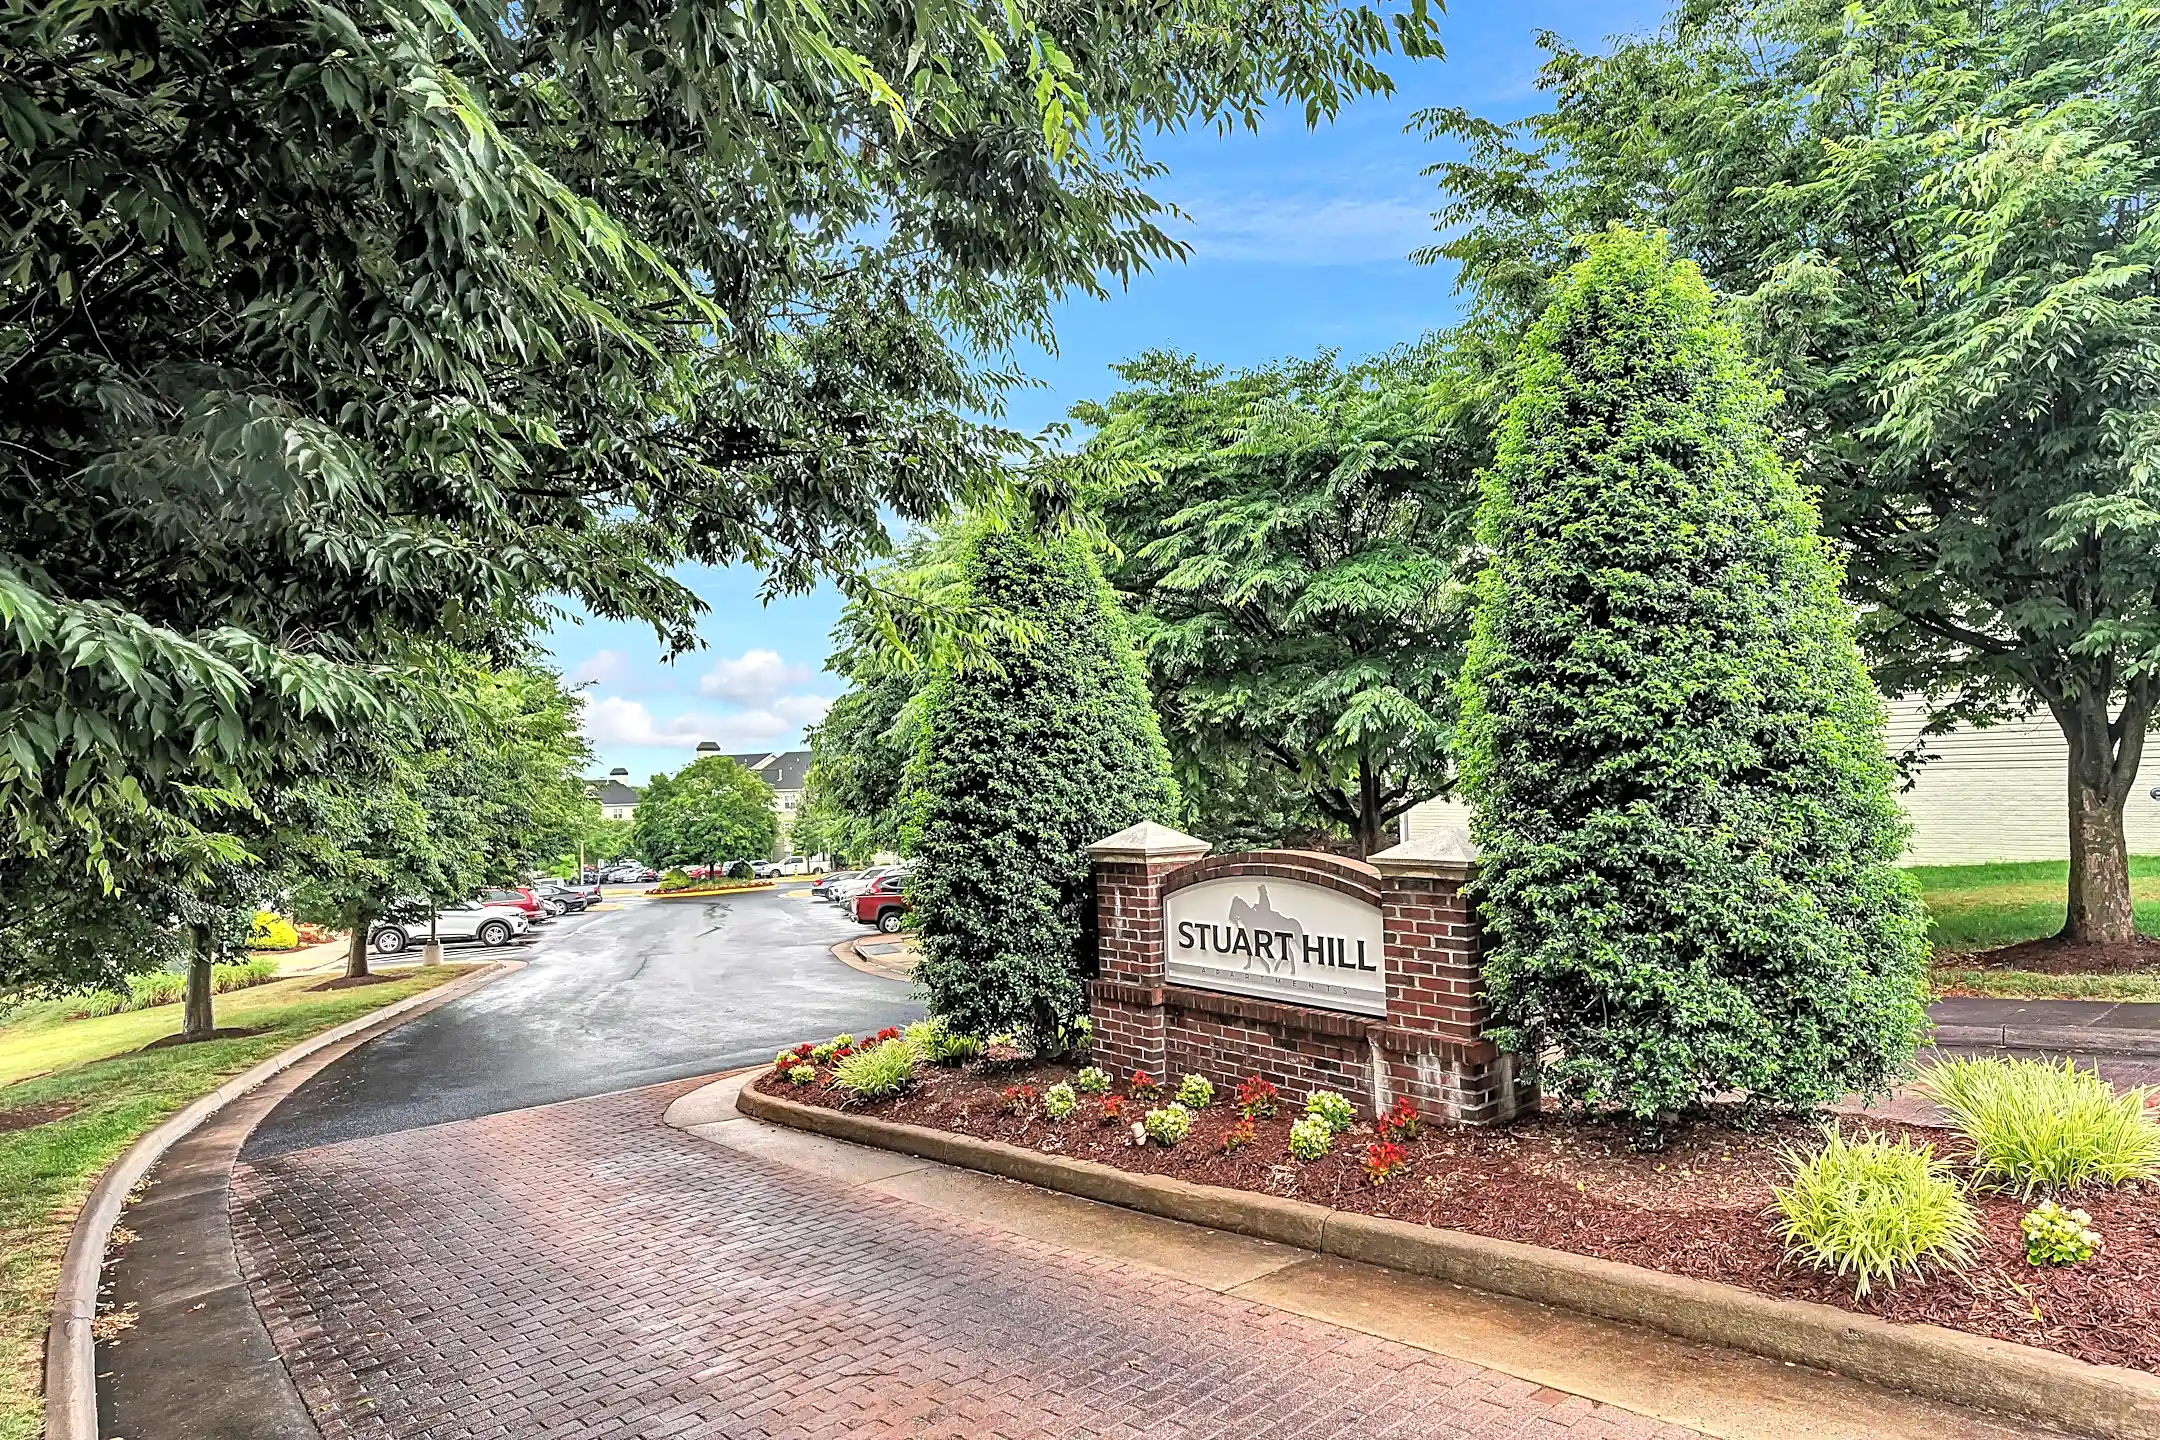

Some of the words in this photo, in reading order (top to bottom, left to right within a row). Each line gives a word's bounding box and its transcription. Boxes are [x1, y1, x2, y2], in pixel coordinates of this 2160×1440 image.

[1178, 921, 1293, 961] STUART
[1302, 934, 1377, 972] HILL
[1201, 967, 1348, 994] APARTMENTS
